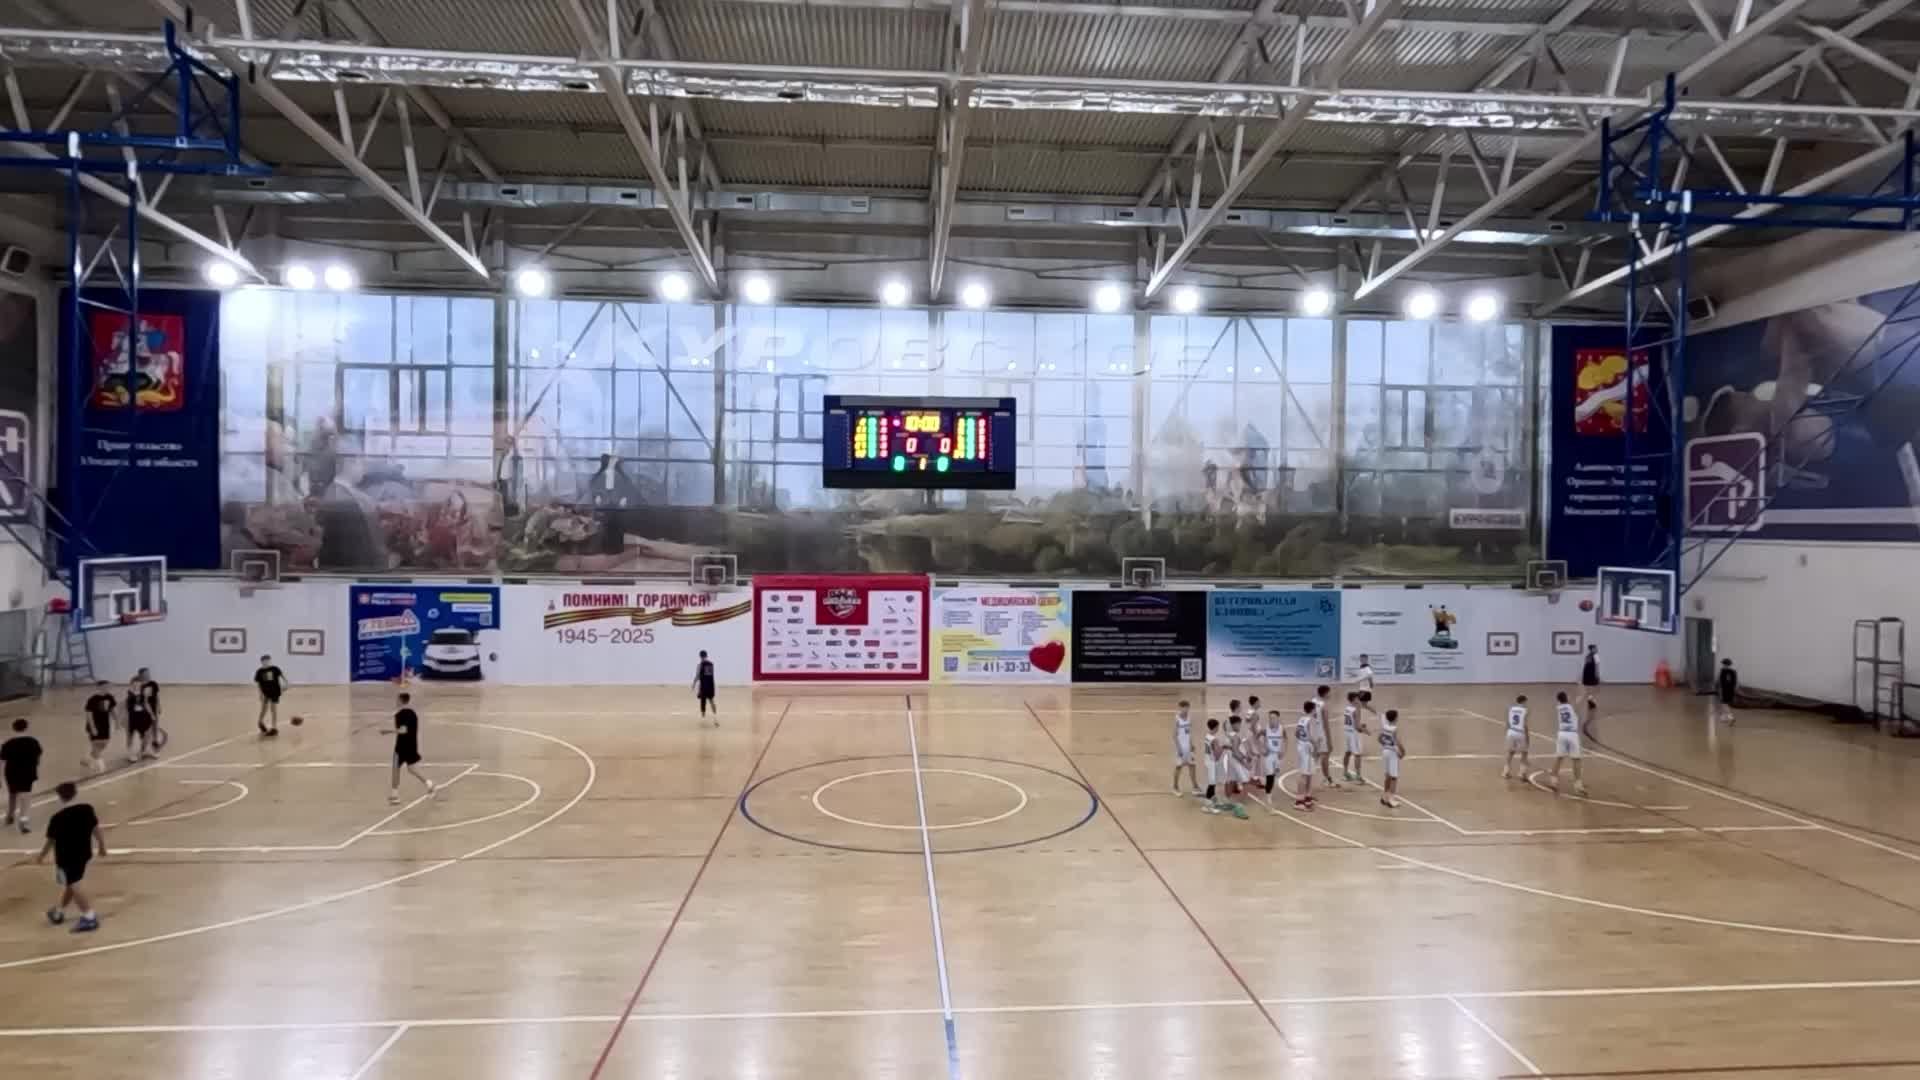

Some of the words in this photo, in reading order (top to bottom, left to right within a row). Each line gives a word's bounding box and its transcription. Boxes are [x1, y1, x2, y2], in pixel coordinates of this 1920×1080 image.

[906, 438, 917, 453] 0
[939, 438, 951, 454] 0
[563, 593, 629, 607] ПОМНИМ!
[636, 593, 711, 608] ГОРДИМСЯ!
[982, 661, 1031, 673] 411-33-33
